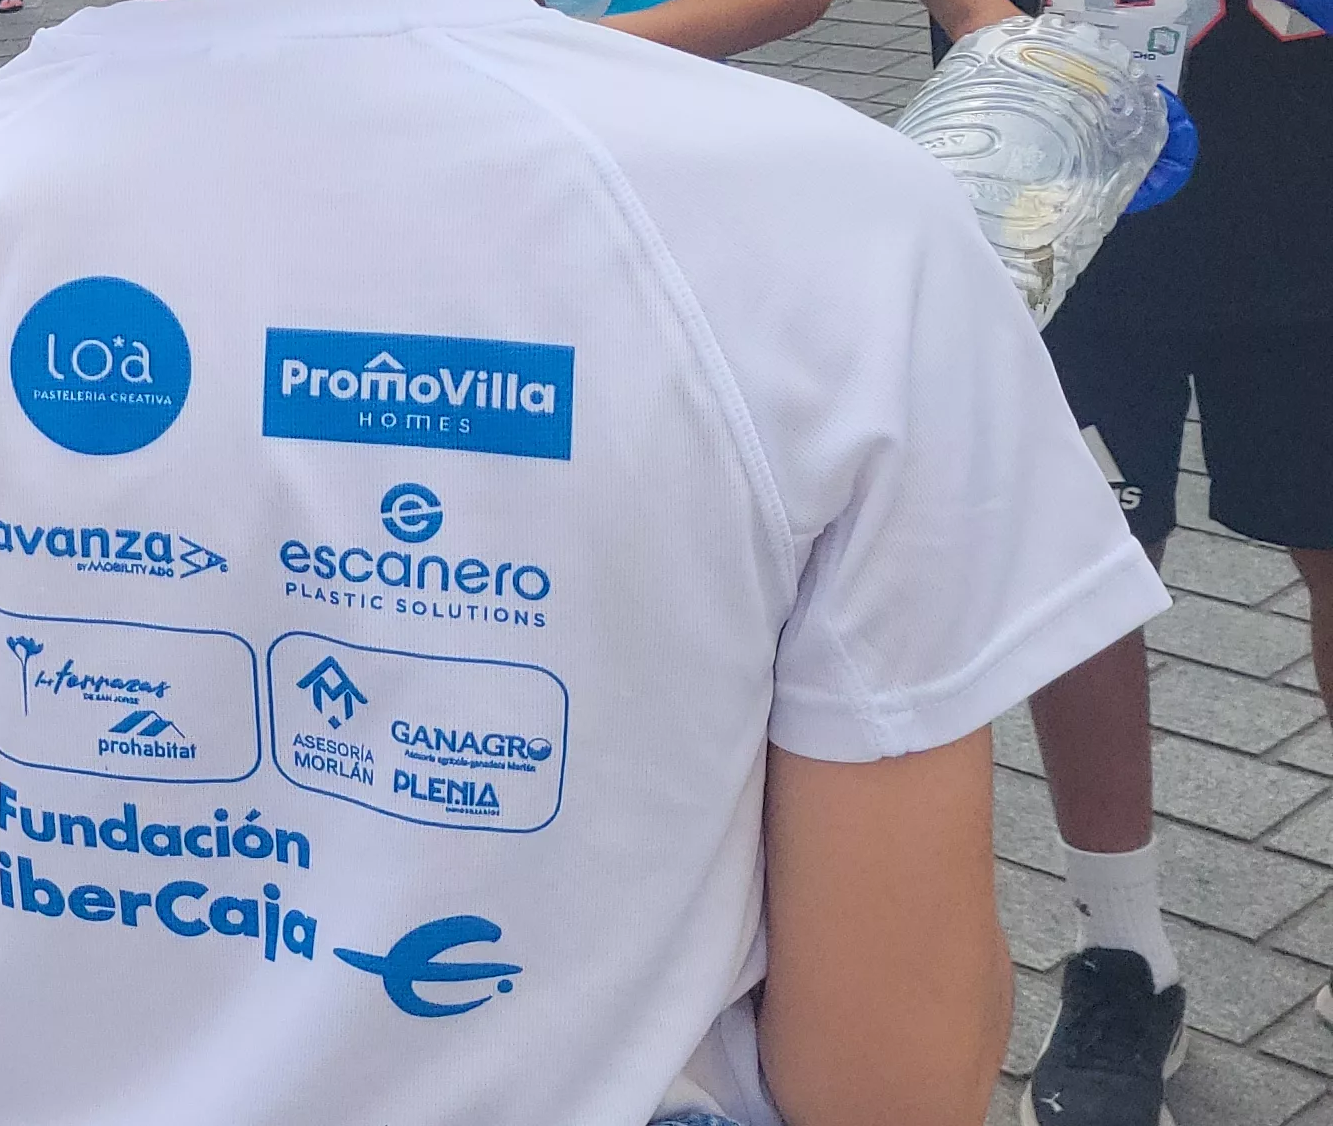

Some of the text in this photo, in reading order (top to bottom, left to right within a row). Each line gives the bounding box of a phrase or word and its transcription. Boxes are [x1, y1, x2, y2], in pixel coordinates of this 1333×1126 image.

[110, 392, 173, 406] CREATIVA
[281, 353, 557, 415] PromoVilla
[358, 411, 472, 434] HOMES
[88, 561, 147, 576] MOBILITY
[149, 566, 175, 578] ADO
[279, 539, 551, 601] escanero
[285, 582, 547, 628] PLASTIC SOLUTIONS
[97, 737, 198, 760] prohabitat
[292, 733, 375, 765] ASESORÍA
[390, 719, 553, 762] GANAGRO
[294, 751, 375, 786] MORLÁN
[393, 768, 500, 809] PLENIA
